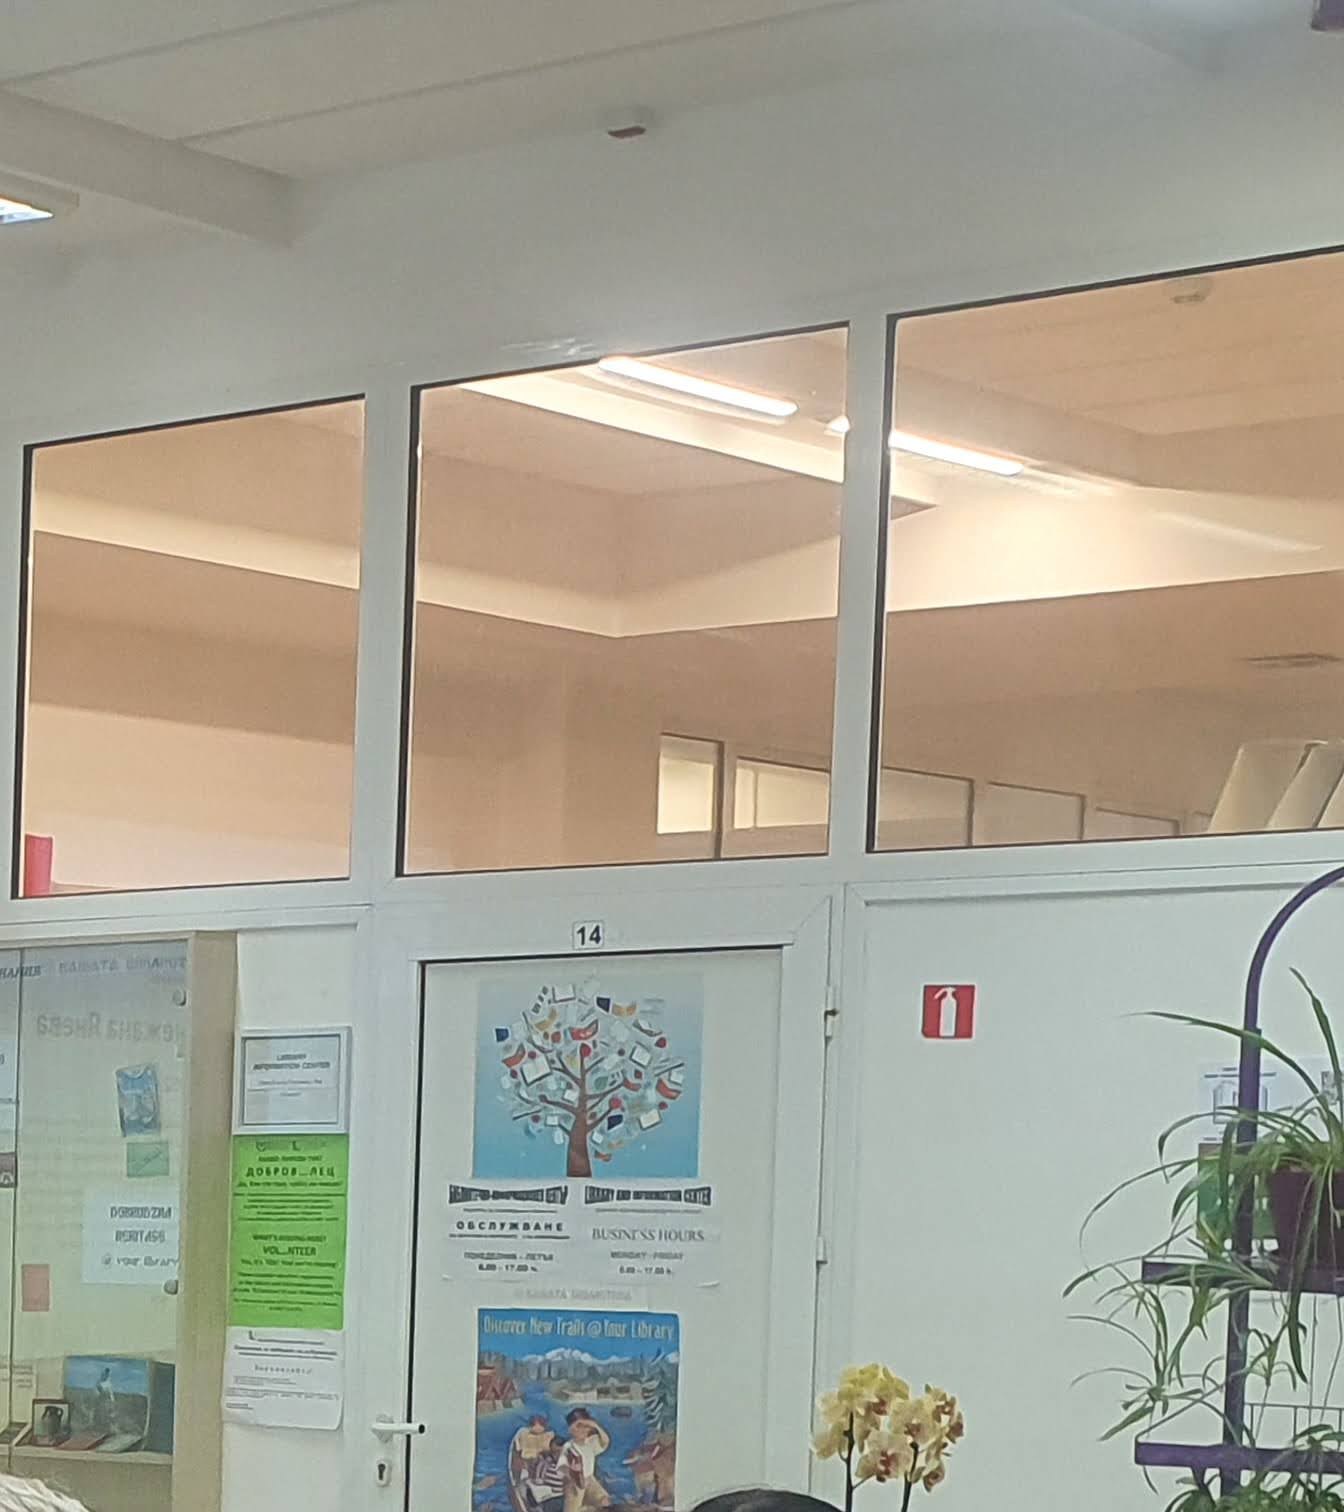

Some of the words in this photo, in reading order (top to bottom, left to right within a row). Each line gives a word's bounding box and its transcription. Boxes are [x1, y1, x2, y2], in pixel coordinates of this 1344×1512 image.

[576, 925, 602, 945] 14
[456, 1220, 564, 1231] ОБСЛУЖВАНЕ
[592, 1228, 656, 1241] BUSINESS
[658, 1228, 705, 1242] HOURS
[483, 1315, 527, 1335] Discover
[529, 1316, 553, 1336] New
[556, 1316, 586, 1337] Trails
[631, 1320, 674, 1342] Library
